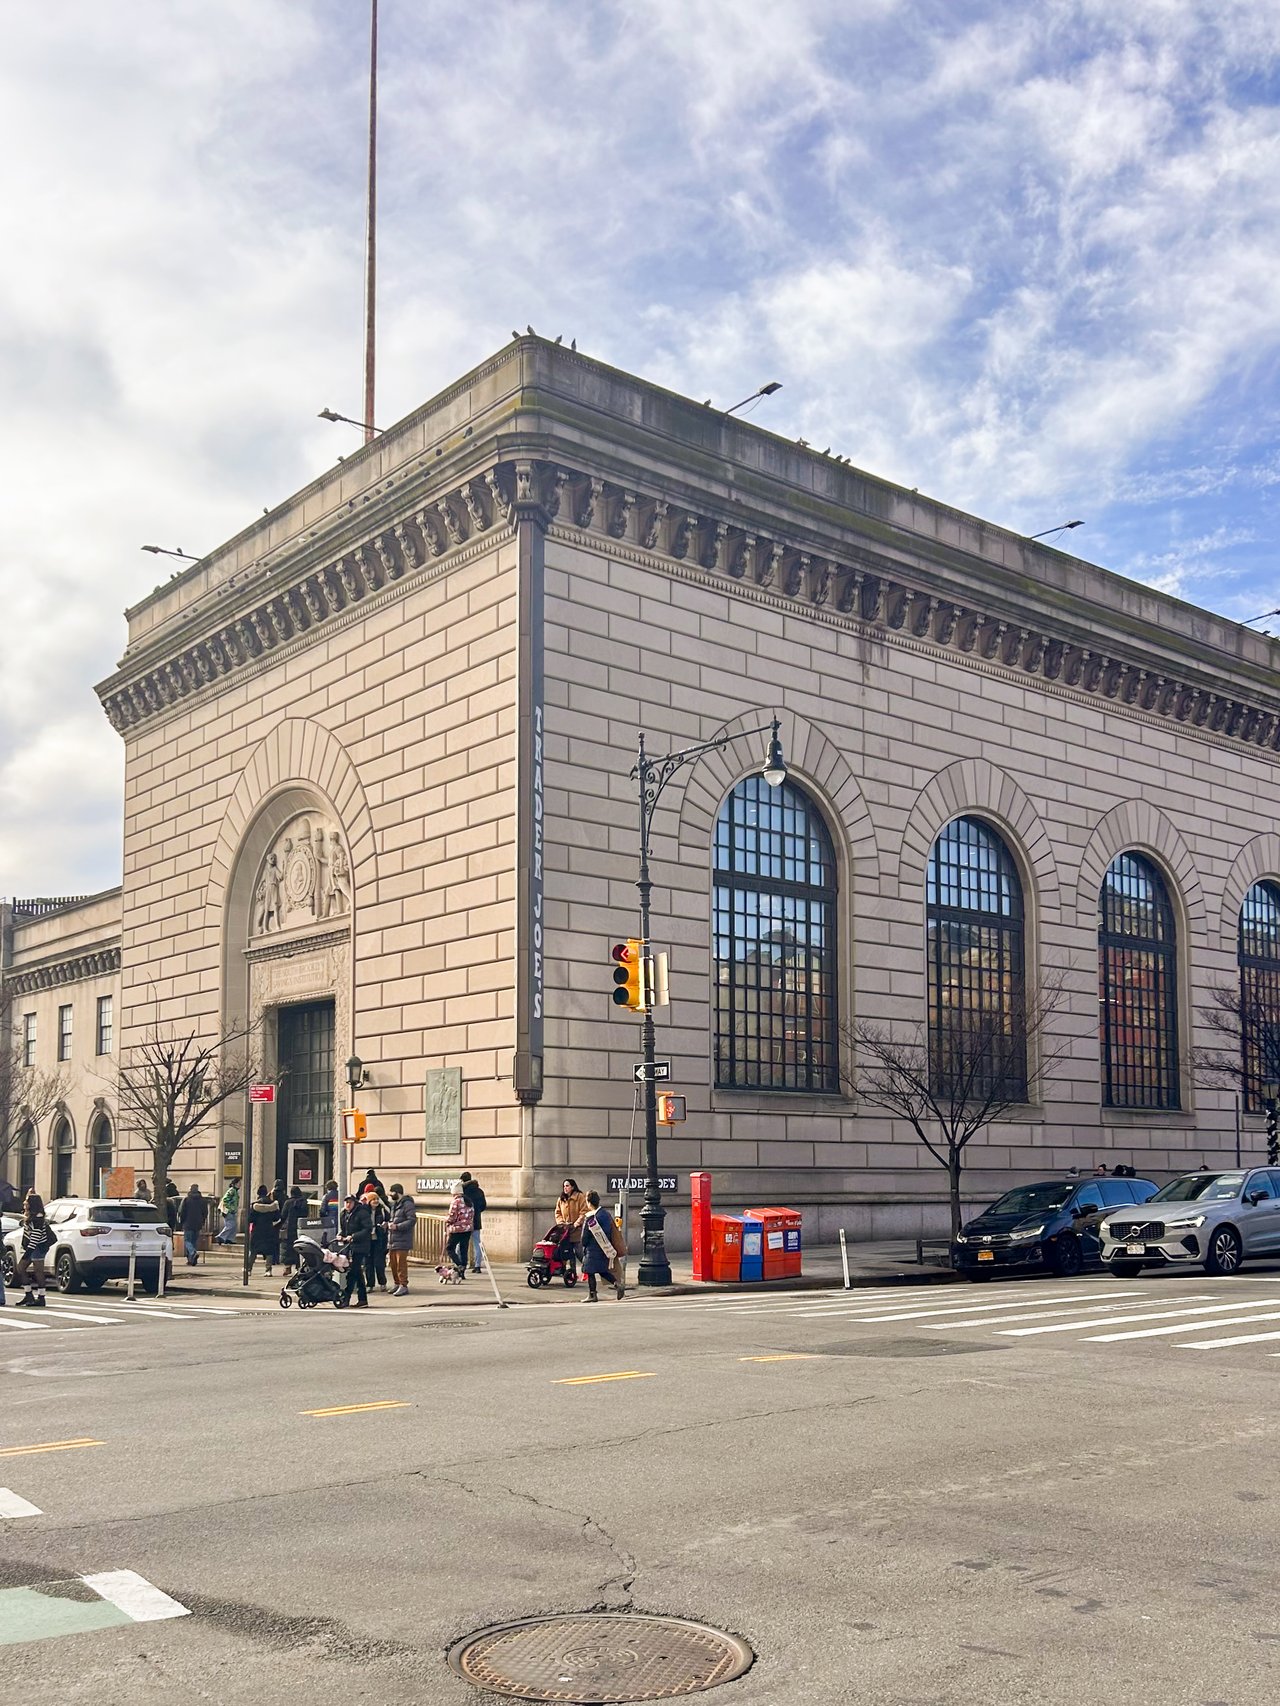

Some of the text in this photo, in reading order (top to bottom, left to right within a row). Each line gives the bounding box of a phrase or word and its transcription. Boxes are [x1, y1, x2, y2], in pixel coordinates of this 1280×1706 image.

[533, 705, 543, 1019] TRADER JOE'S
[417, 1179, 444, 1189] TRADER
